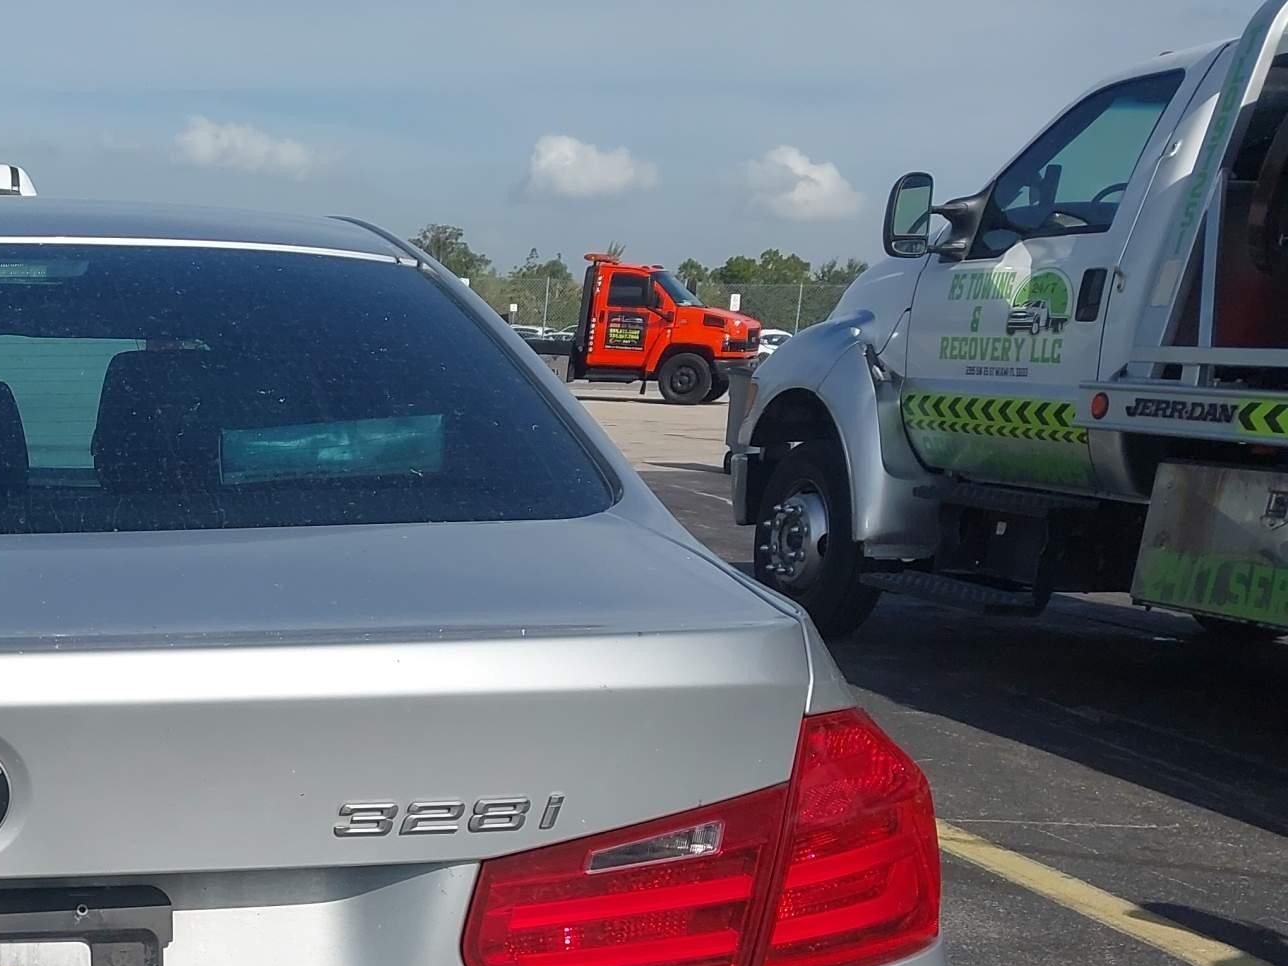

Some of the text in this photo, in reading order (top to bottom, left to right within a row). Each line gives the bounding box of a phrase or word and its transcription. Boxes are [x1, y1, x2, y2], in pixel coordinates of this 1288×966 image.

[966, 272, 1018, 300] TOWING
[939, 336, 1063, 364] RECOVERY LLC
[333, 794, 566, 838] 328i
